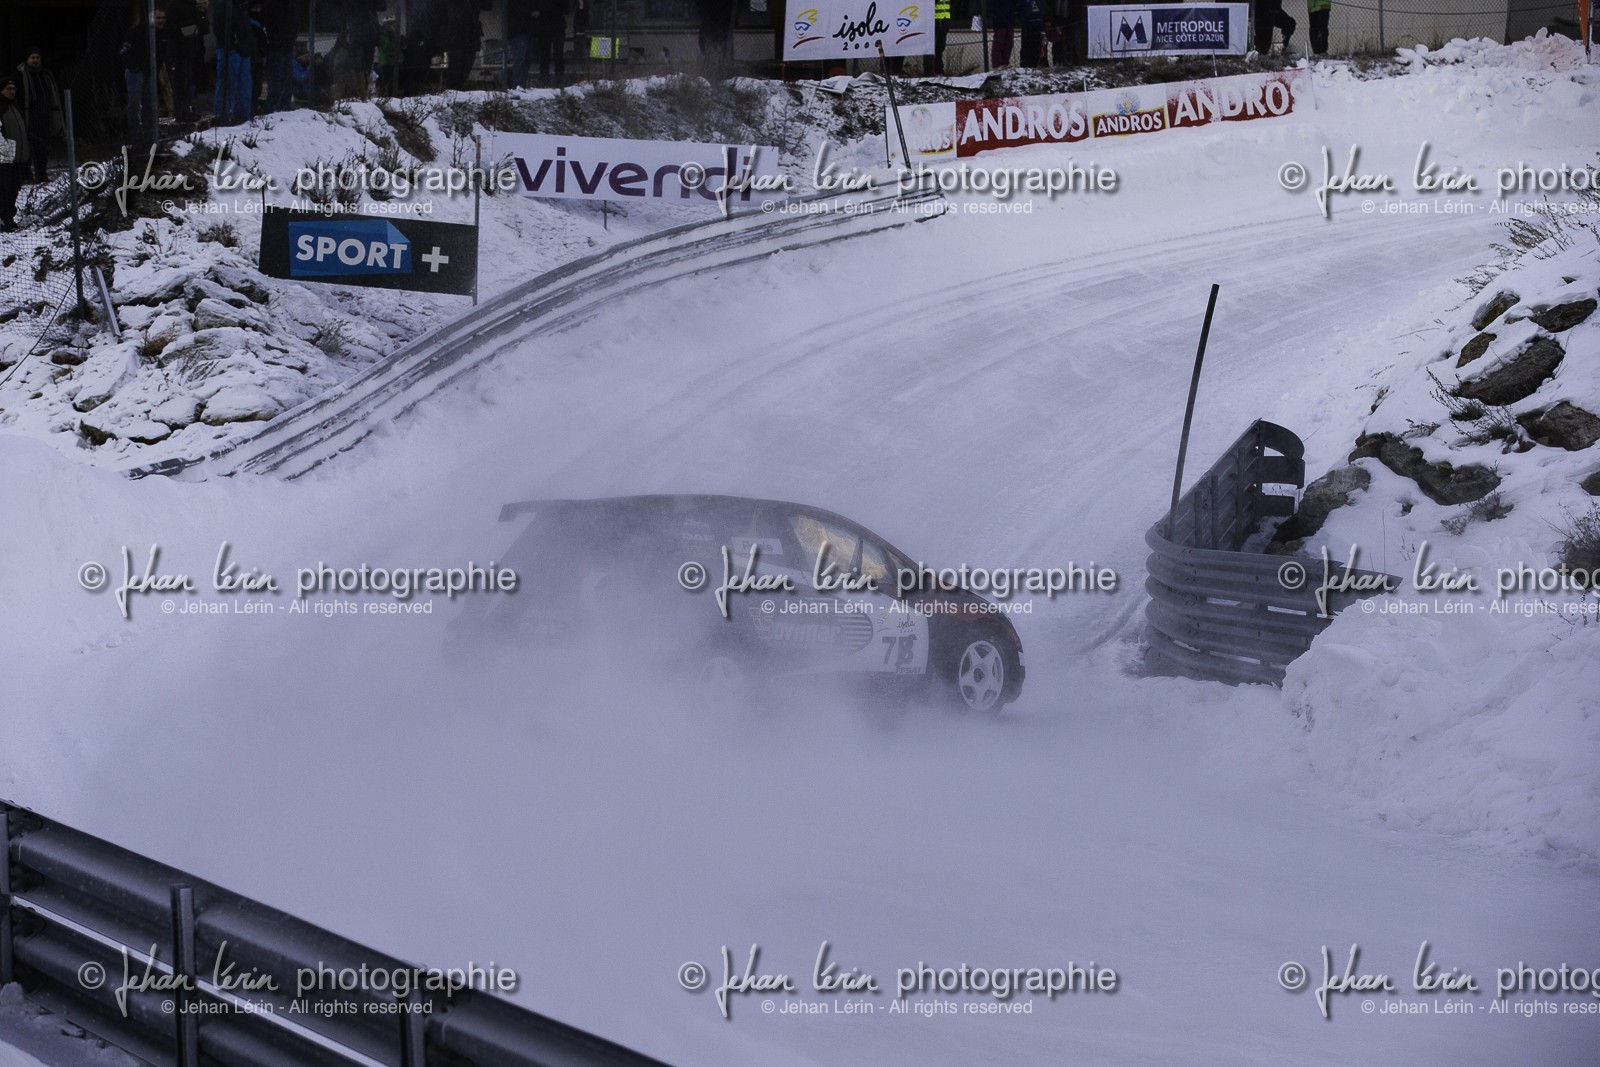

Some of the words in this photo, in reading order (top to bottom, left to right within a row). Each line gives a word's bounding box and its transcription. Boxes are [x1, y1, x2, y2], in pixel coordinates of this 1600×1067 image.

[832, 1, 890, 42] isola
[1156, 34, 1174, 43] NICE
[1175, 32, 1197, 43] CÔTE
[1198, 33, 1225, 42] D'AZUR
[960, 100, 1085, 146] ANDROS
[1097, 111, 1163, 134] ANDROS
[514, 146, 751, 202] vivendi
[295, 234, 408, 269] SPORT
